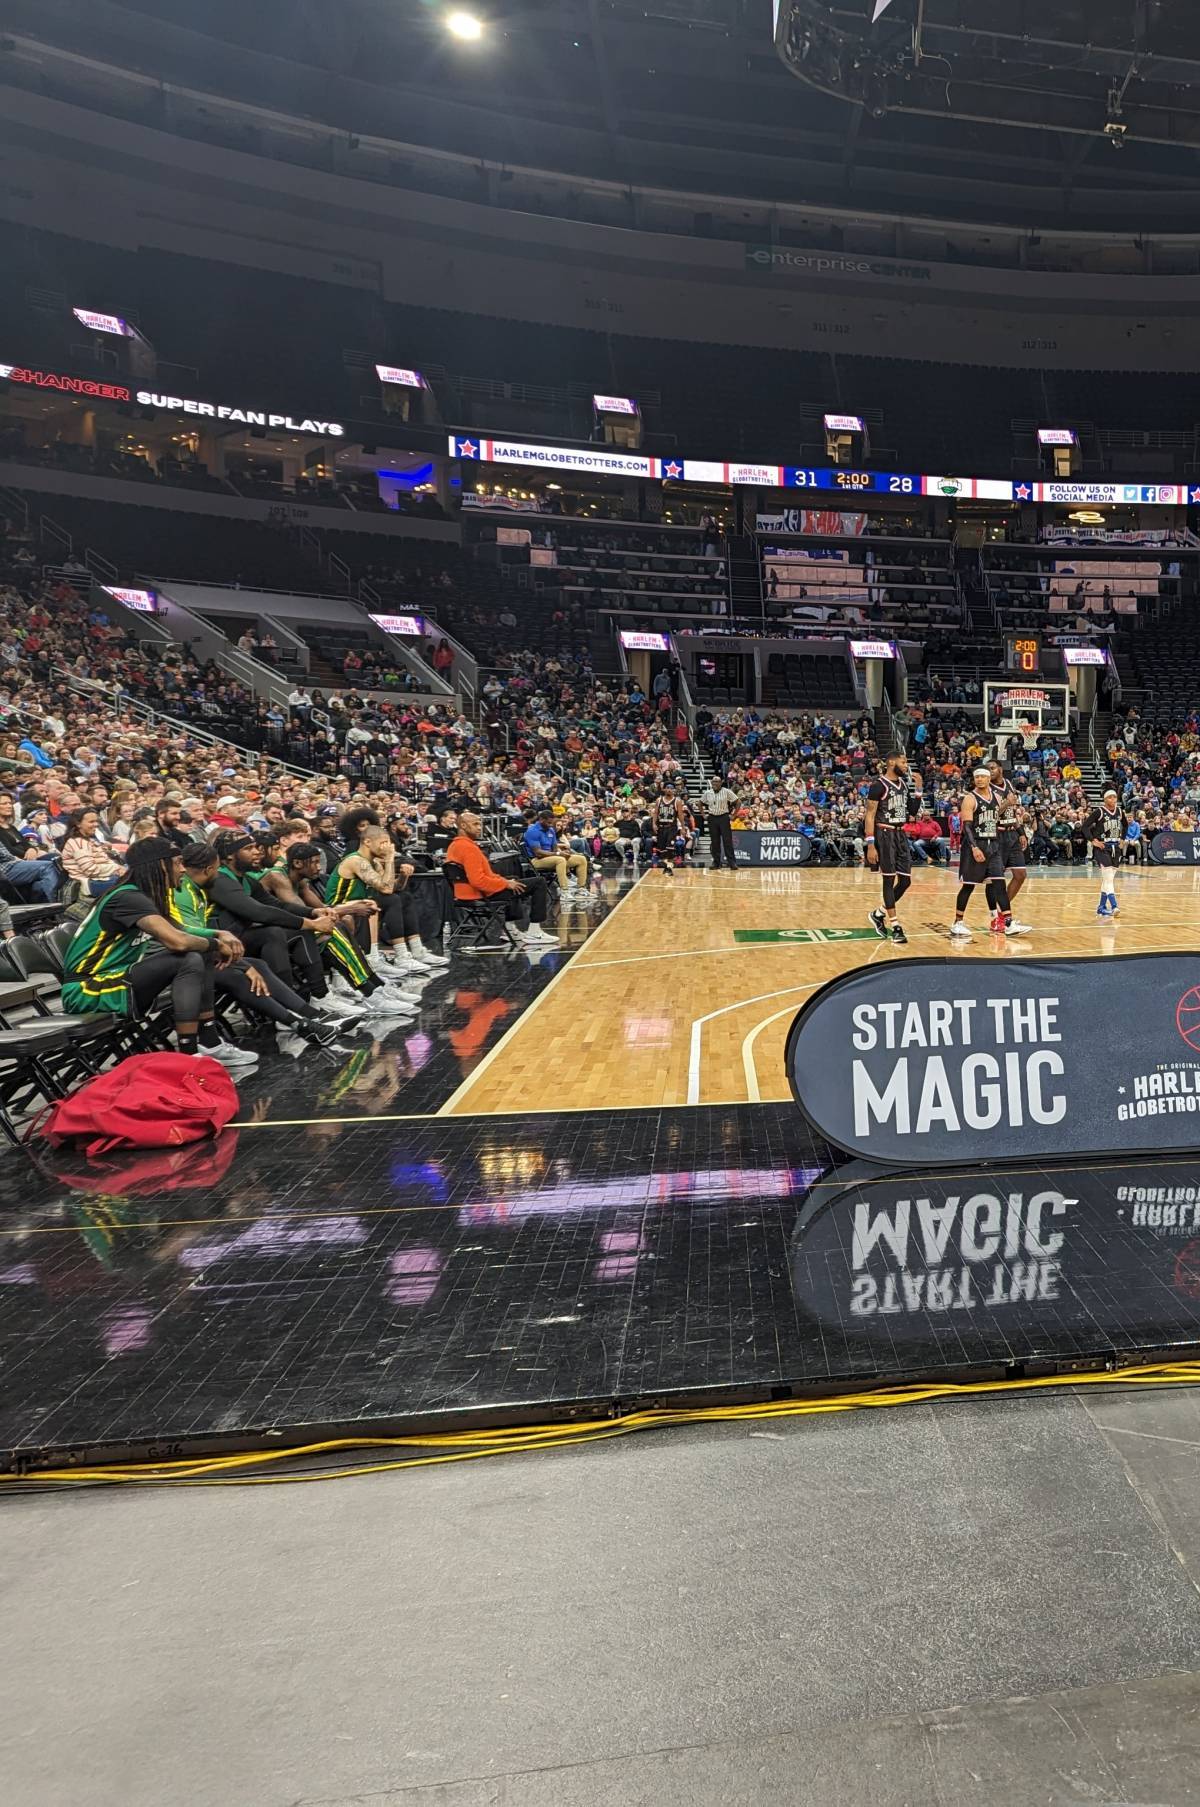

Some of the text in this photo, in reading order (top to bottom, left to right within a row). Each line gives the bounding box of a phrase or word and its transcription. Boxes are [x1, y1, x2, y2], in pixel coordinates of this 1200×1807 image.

[747, 247, 932, 281] enterprise CENTER
[136, 391, 215, 418] SUPER
[217, 405, 265, 427] FAN
[268, 413, 345, 437] PLAYS
[494, 446, 649, 473] HARLEMGLOBETROTTERS.COM
[737, 467, 768, 479] HARLEM
[794, 470, 818, 487] 31
[836, 472, 870, 486] 2:00
[888, 477, 914, 493] 28
[1049, 484, 1117, 495] FOLLOW US ON
[1050, 493, 1114, 502] SOCIAL MEDIA
[1015, 640, 1037, 651] 2:00
[1022, 652, 1034, 670] 0
[1007, 688, 1045, 700] HARLEM
[1001, 698, 1051, 710] GLOBETROTTERS
[761, 836, 801, 846] START THE
[760, 846, 801, 861] MAGIC
[852, 997, 1062, 1051] START THE
[1156, 1062, 1200, 1071] THE ORIGINAL
[852, 1049, 1068, 1138] MAGIC
